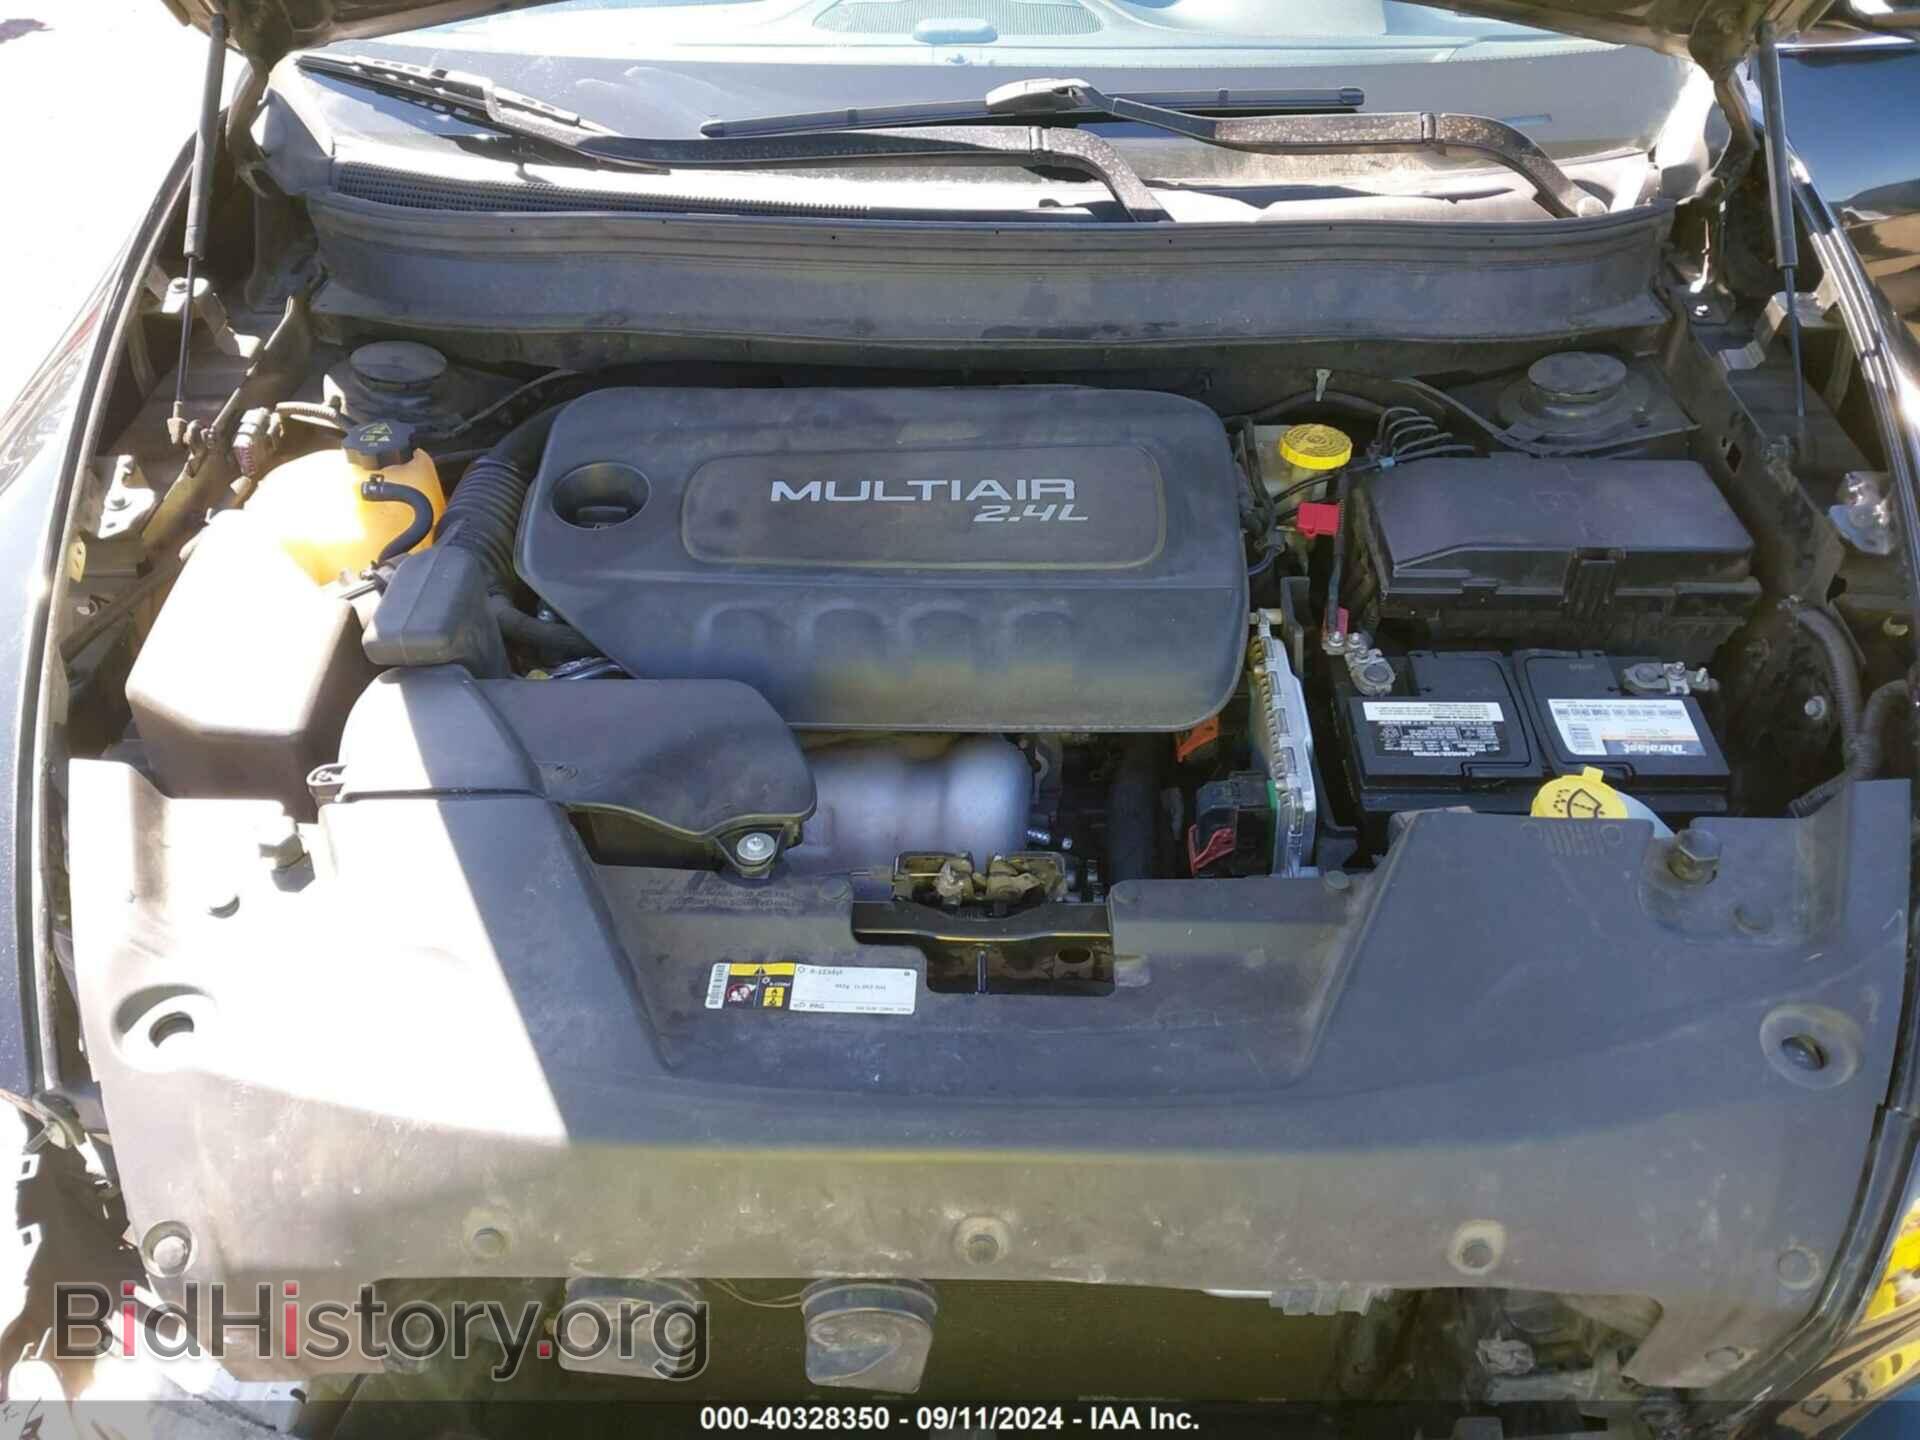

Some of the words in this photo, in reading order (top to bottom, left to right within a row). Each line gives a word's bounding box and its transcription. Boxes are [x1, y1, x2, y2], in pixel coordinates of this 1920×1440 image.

[770, 479, 1076, 502] MULTIAIR
[973, 503, 1089, 522] 2.4L
[1623, 743, 1687, 756] Duralast
